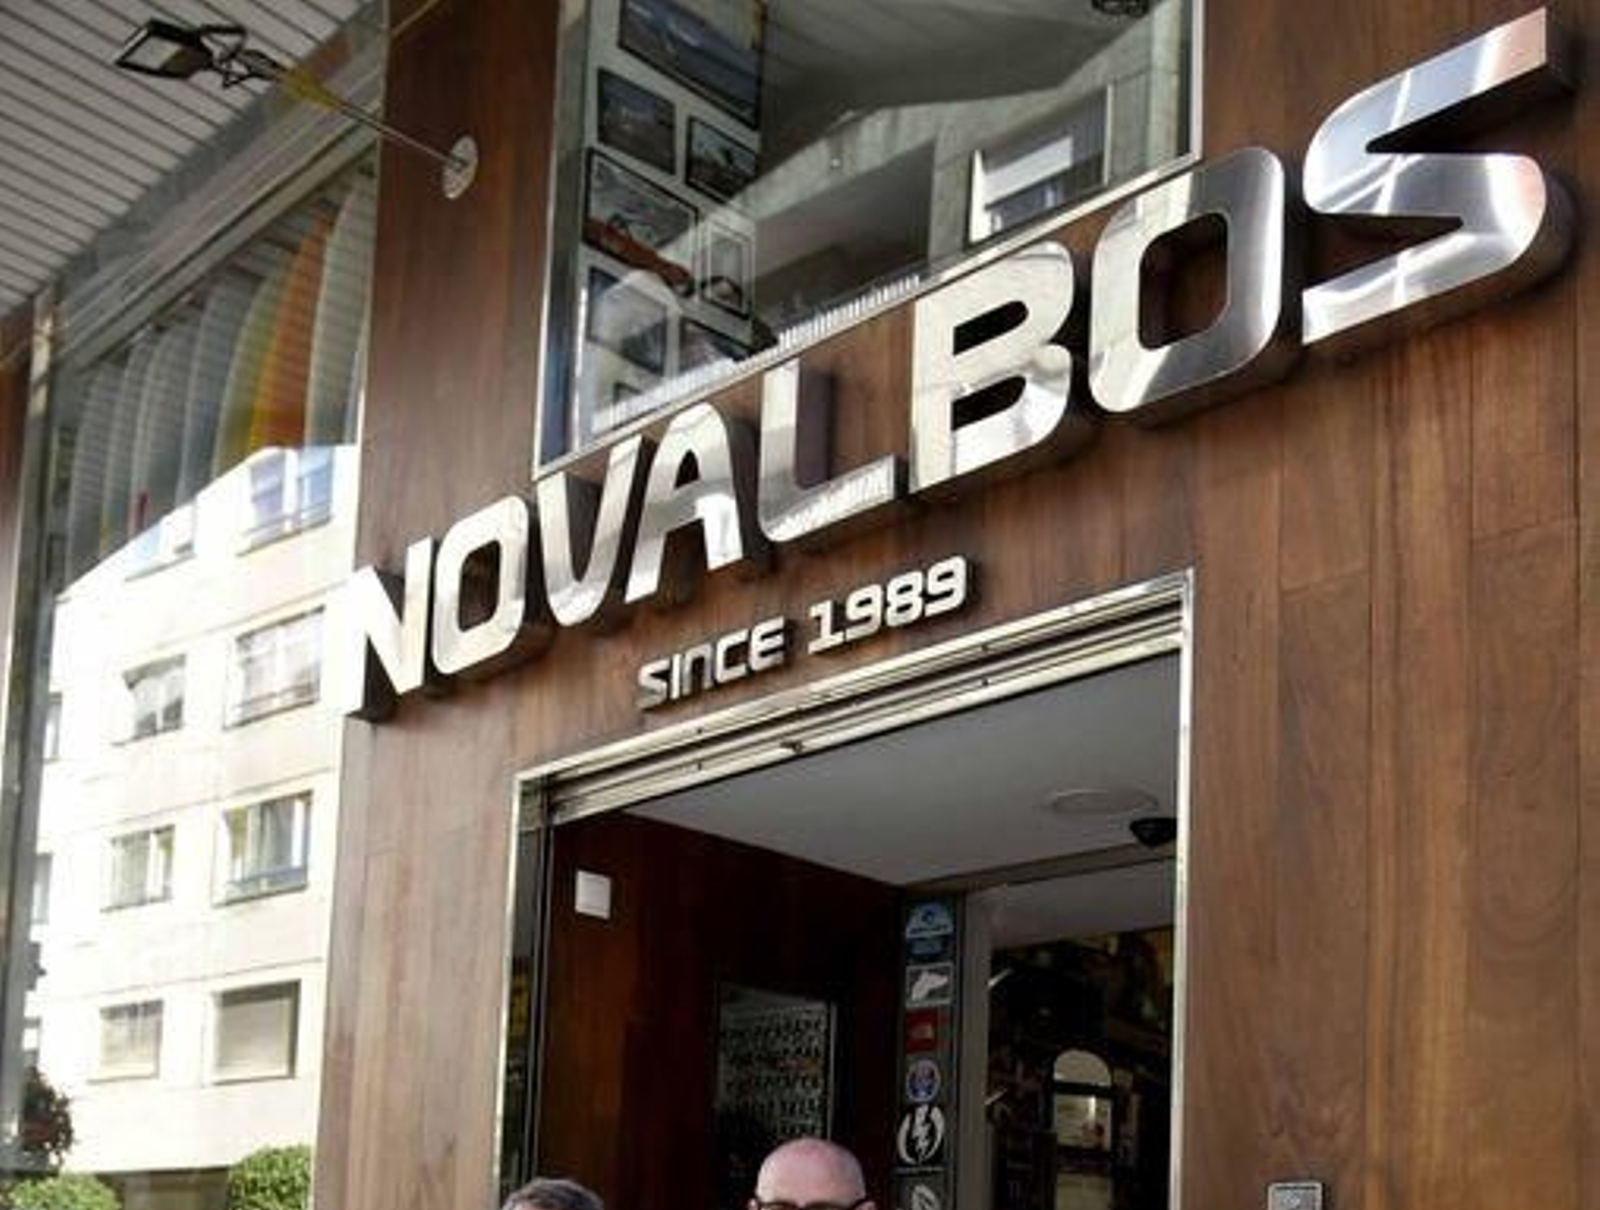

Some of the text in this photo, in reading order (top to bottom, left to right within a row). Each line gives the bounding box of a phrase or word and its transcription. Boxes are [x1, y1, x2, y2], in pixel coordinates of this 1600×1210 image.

[321, 6, 1547, 716] NOVALBOS
[637, 556, 968, 710] SINCE 1989
